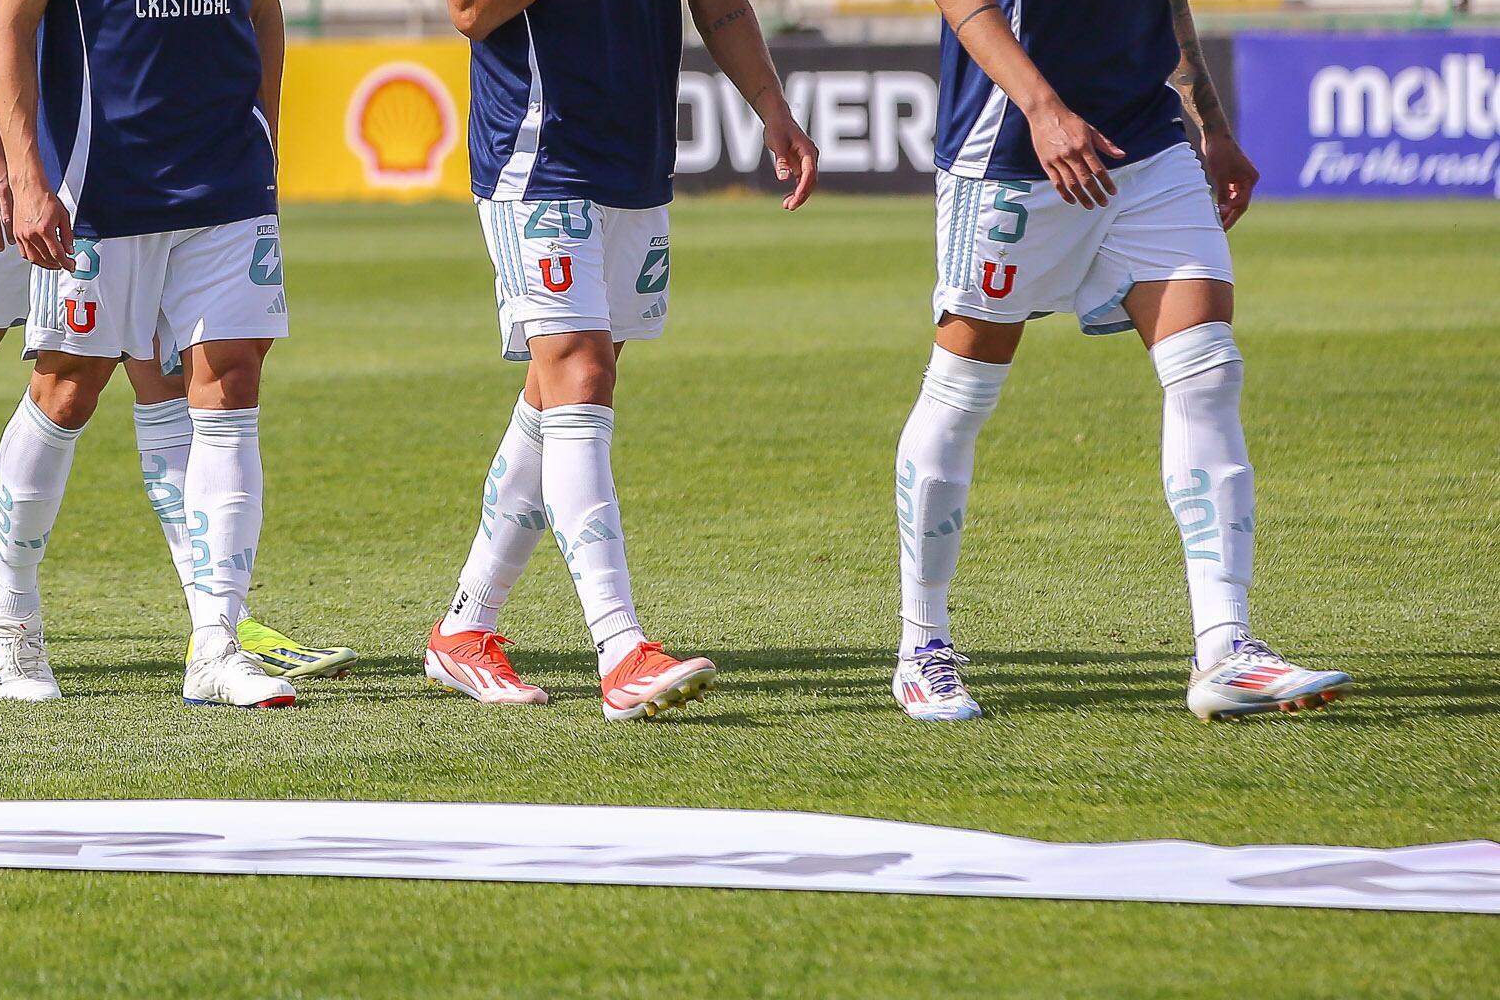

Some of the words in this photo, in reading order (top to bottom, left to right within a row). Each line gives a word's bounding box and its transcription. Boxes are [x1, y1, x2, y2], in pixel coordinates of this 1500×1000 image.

[1309, 53, 1500, 141] molt
[987, 180, 1032, 243] 5
[538, 254, 574, 293] U
[980, 260, 1016, 299] U
[64, 299, 98, 335] U
